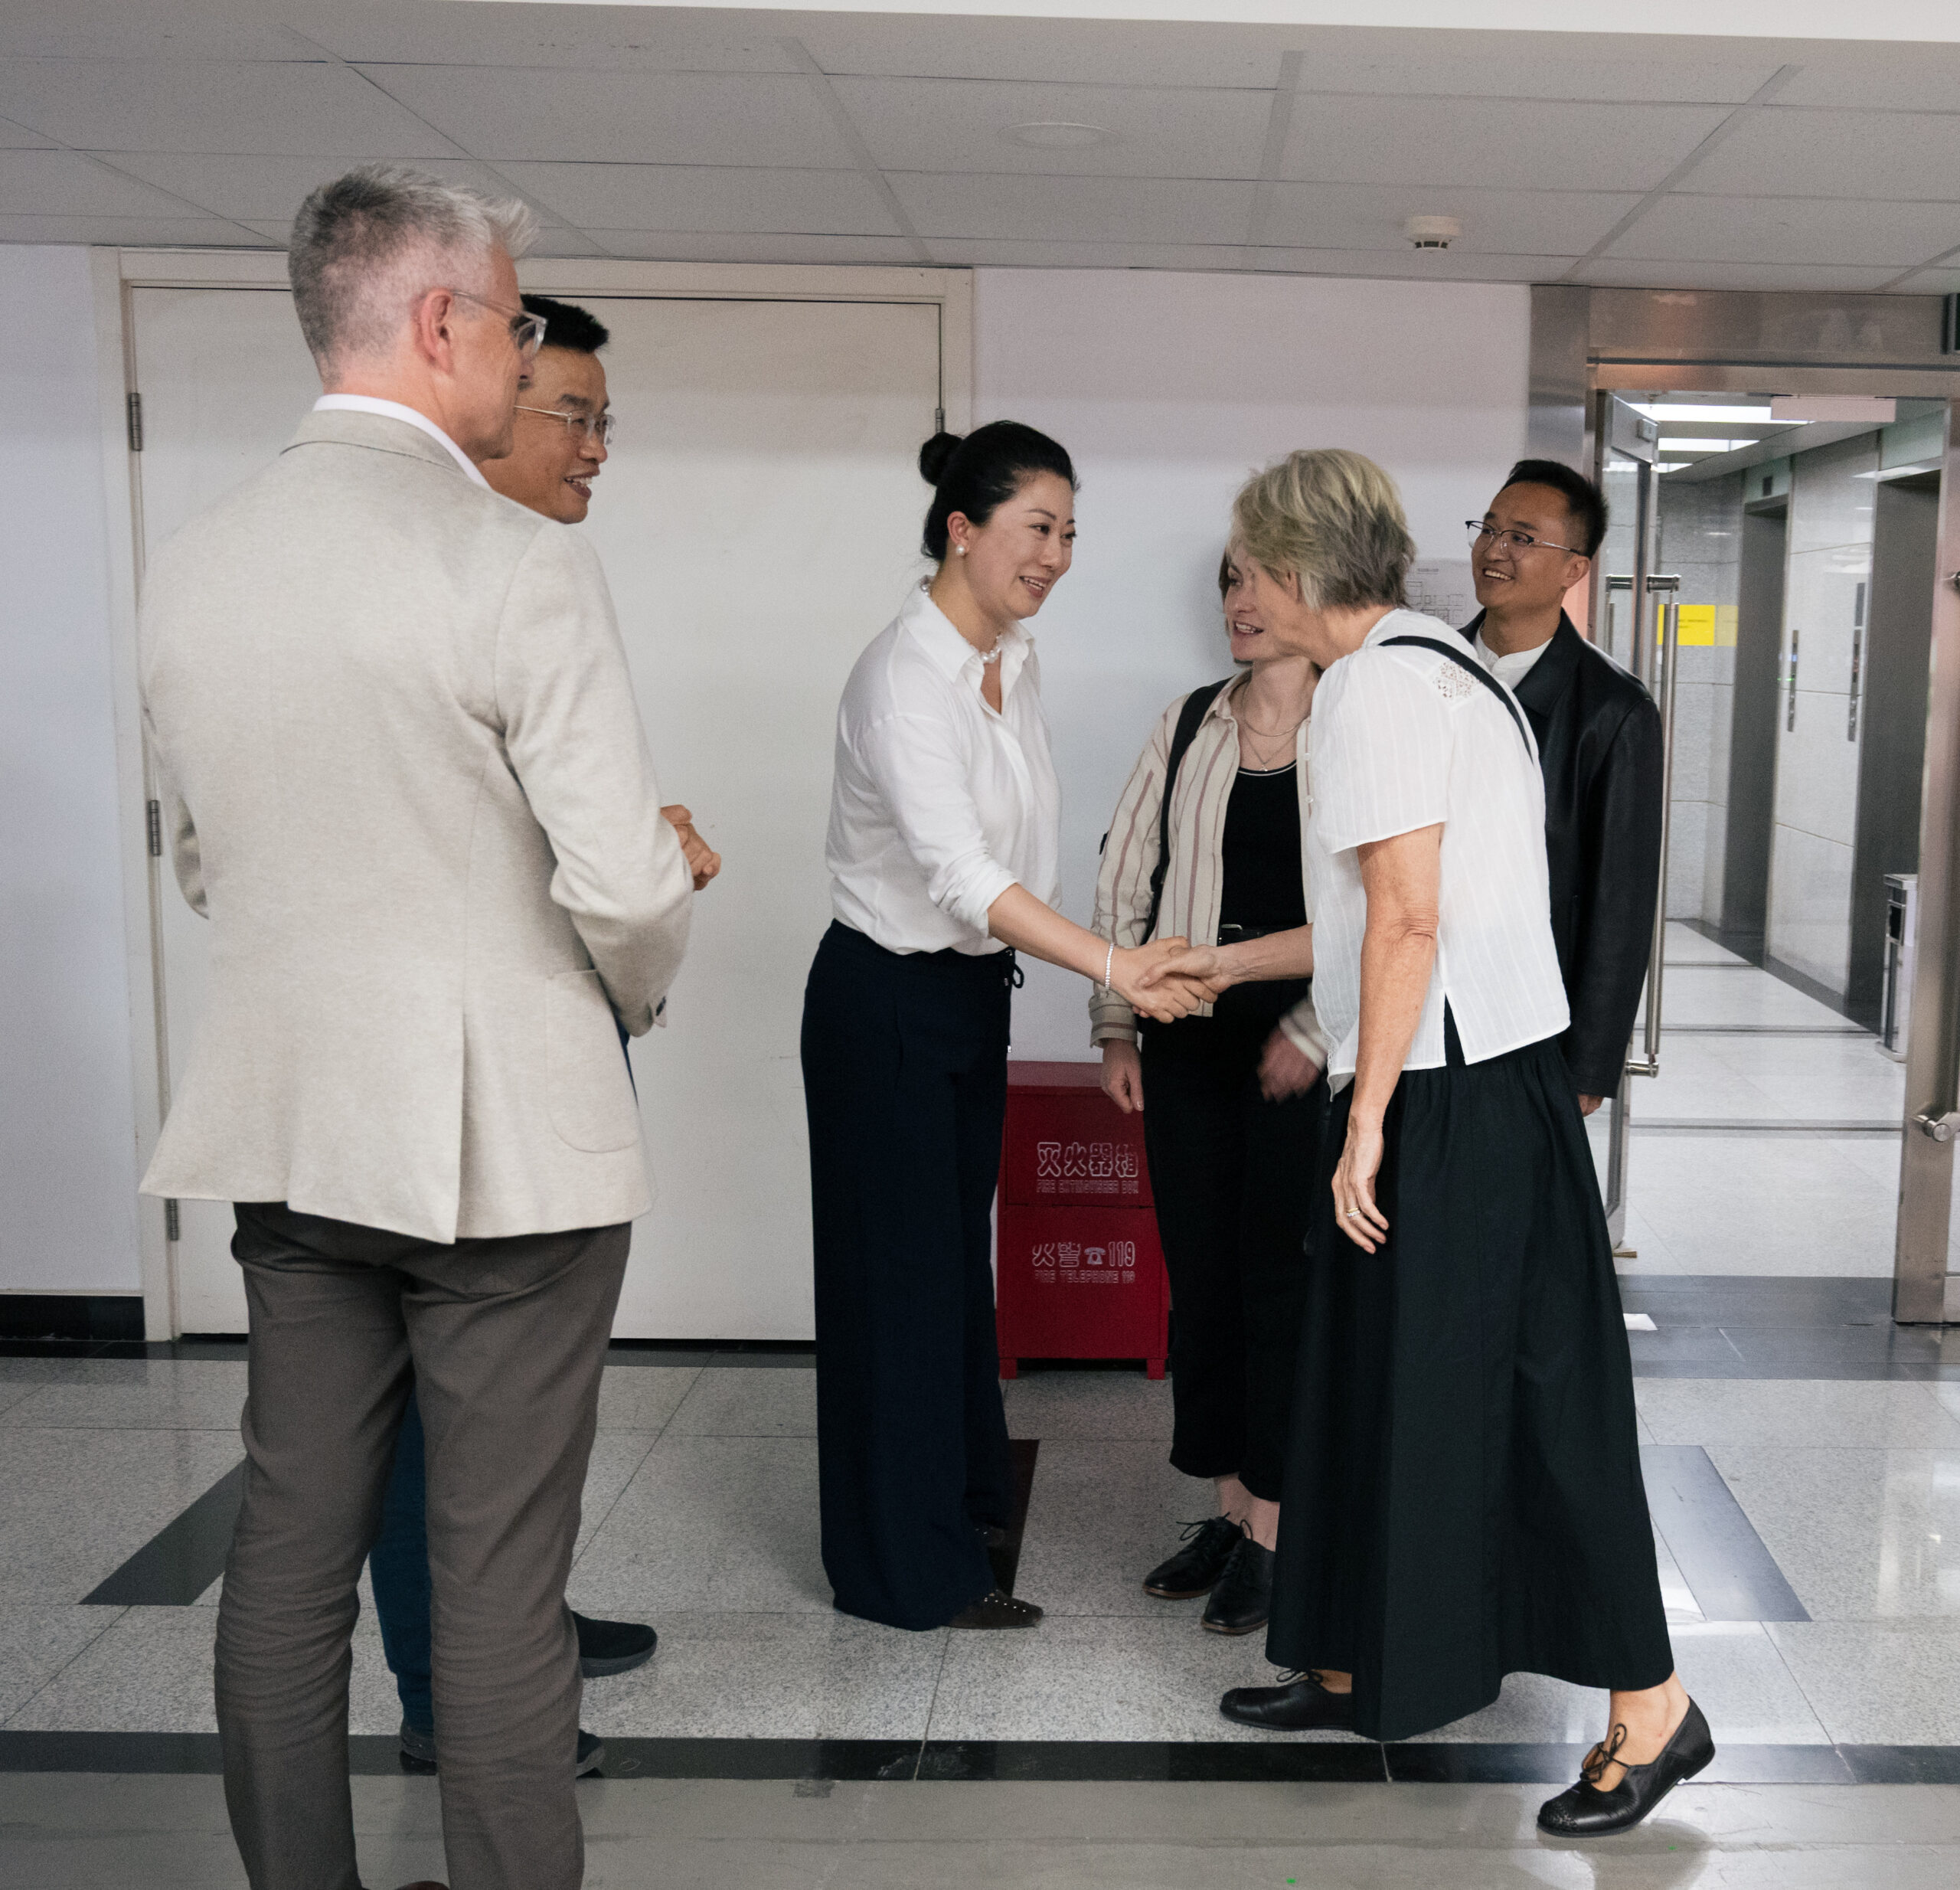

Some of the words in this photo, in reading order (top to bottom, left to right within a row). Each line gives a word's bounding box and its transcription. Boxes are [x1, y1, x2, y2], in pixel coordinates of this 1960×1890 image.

[1037, 1141, 1138, 1178] 灭火器箱
[1036, 1179, 1056, 1193] FIRE
[1059, 1179, 1119, 1194] EXTINGUISHER
[1122, 1180, 1138, 1194] BOX
[1108, 1241, 1135, 1267] 119
[1034, 1270, 1056, 1283] FIRE
[1060, 1270, 1119, 1283] TELEPHONE
[1122, 1270, 1135, 1284] 119
